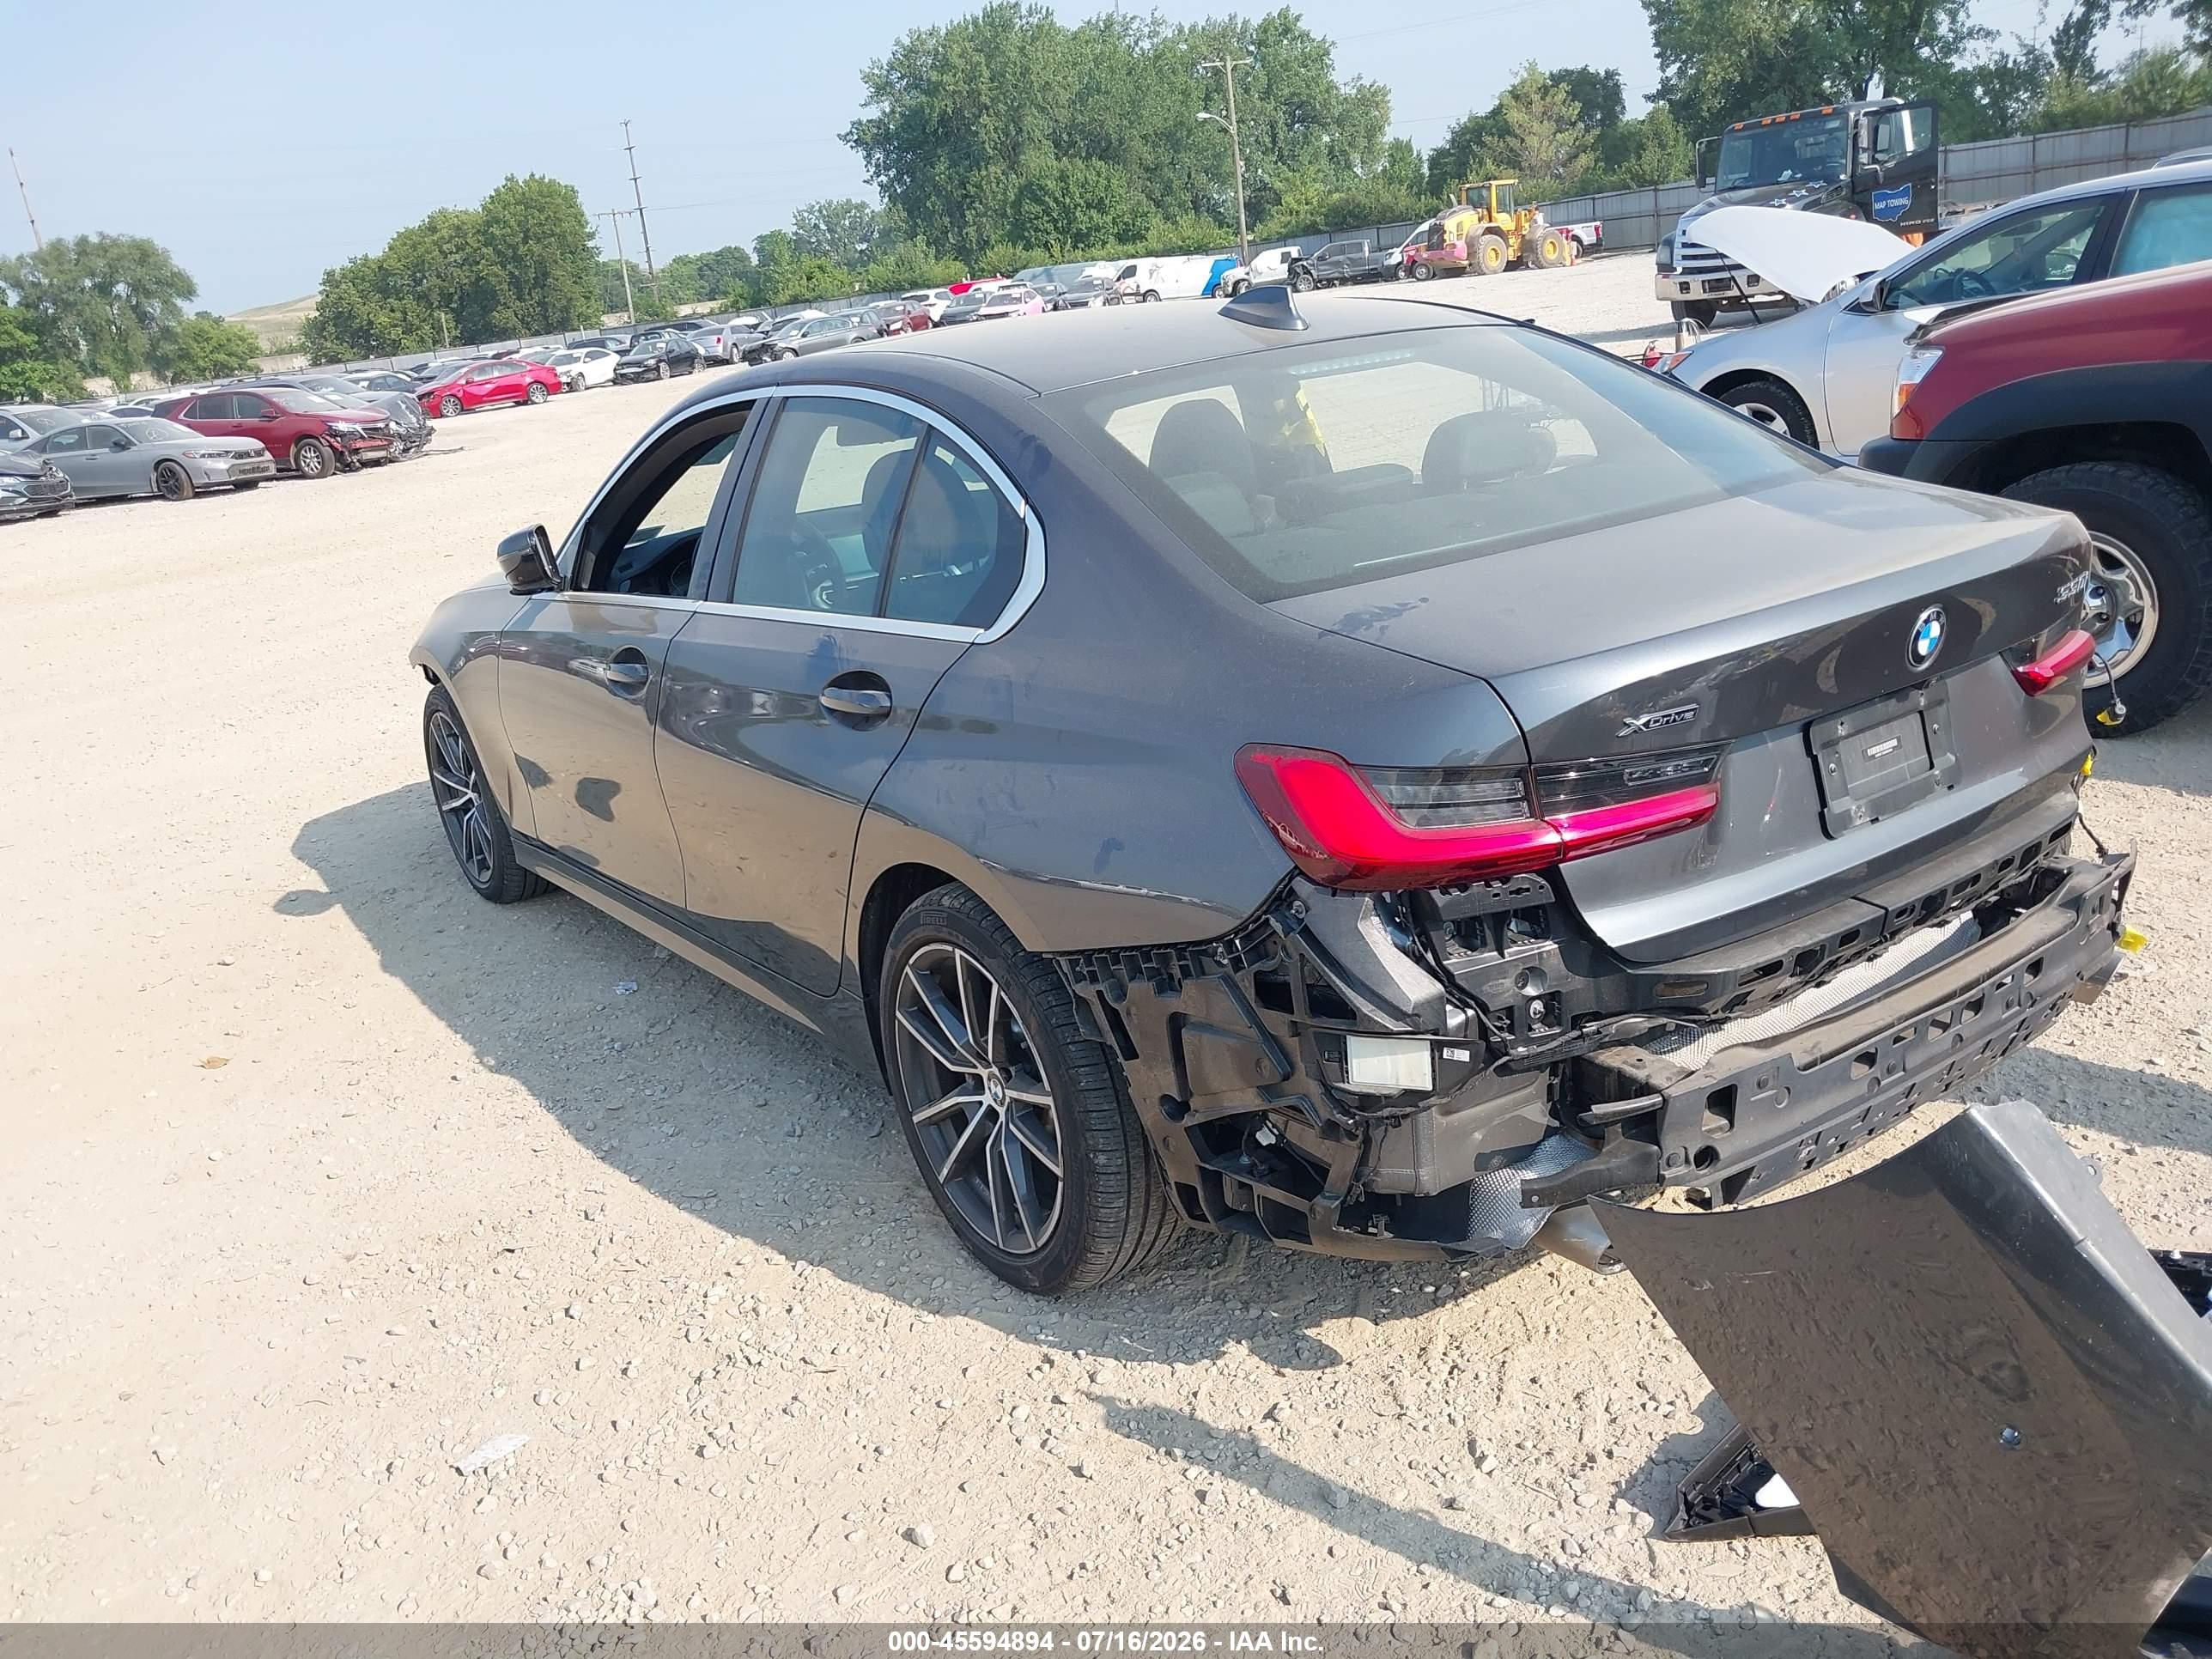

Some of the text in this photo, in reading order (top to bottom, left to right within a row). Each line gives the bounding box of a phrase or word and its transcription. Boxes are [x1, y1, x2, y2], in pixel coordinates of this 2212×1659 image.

[1875, 197, 1909, 210] MAP TOWING
[920, 911, 948, 926] PIRELLI
